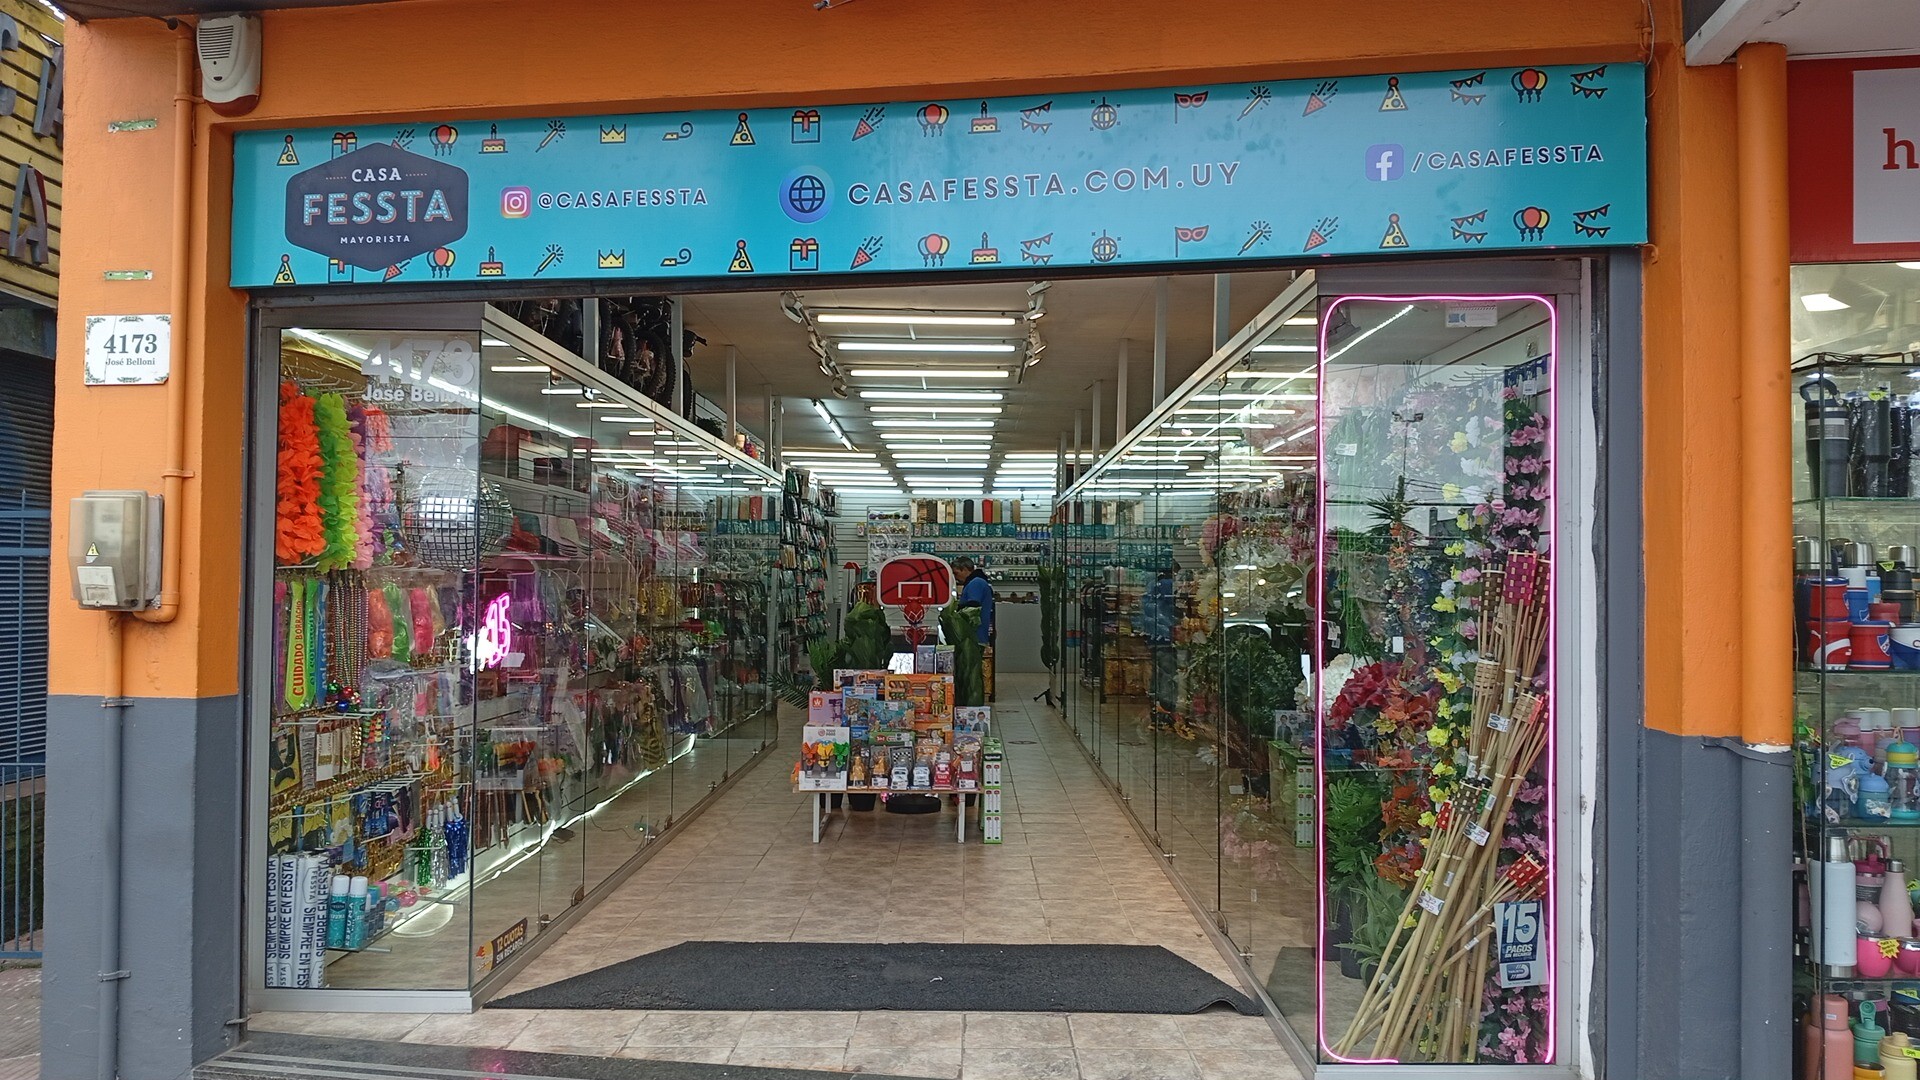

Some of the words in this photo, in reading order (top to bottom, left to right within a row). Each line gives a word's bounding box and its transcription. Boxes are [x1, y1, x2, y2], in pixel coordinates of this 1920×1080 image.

[351, 167, 402, 182] CASA
[848, 161, 1241, 206] CASAFESSTA.COM.UY
[303, 189, 453, 226] FESSTA
[537, 188, 708, 210] @CASAFESSTA
[340, 234, 411, 244] MAYORISTA
[103, 333, 158, 354] 4173
[106, 357, 124, 366] José
[126, 357, 156, 366] Belloni
[361, 339, 475, 386] 4173
[361, 384, 405, 402] José
[295, 600, 304, 640] BORRACHO
[292, 643, 305, 696] CUIDADO
[280, 861, 294, 899] FESSTA
[267, 900, 277, 914] EN
[280, 900, 293, 914] EN
[267, 916, 277, 959] SIEMPRE
[279, 916, 292, 959] SIEMPRE
[300, 907, 317, 950] SIEMPRE
[1504, 902, 1538, 944] 15
[299, 952, 311, 967] EN
[1505, 943, 1533, 954] PAGOS
